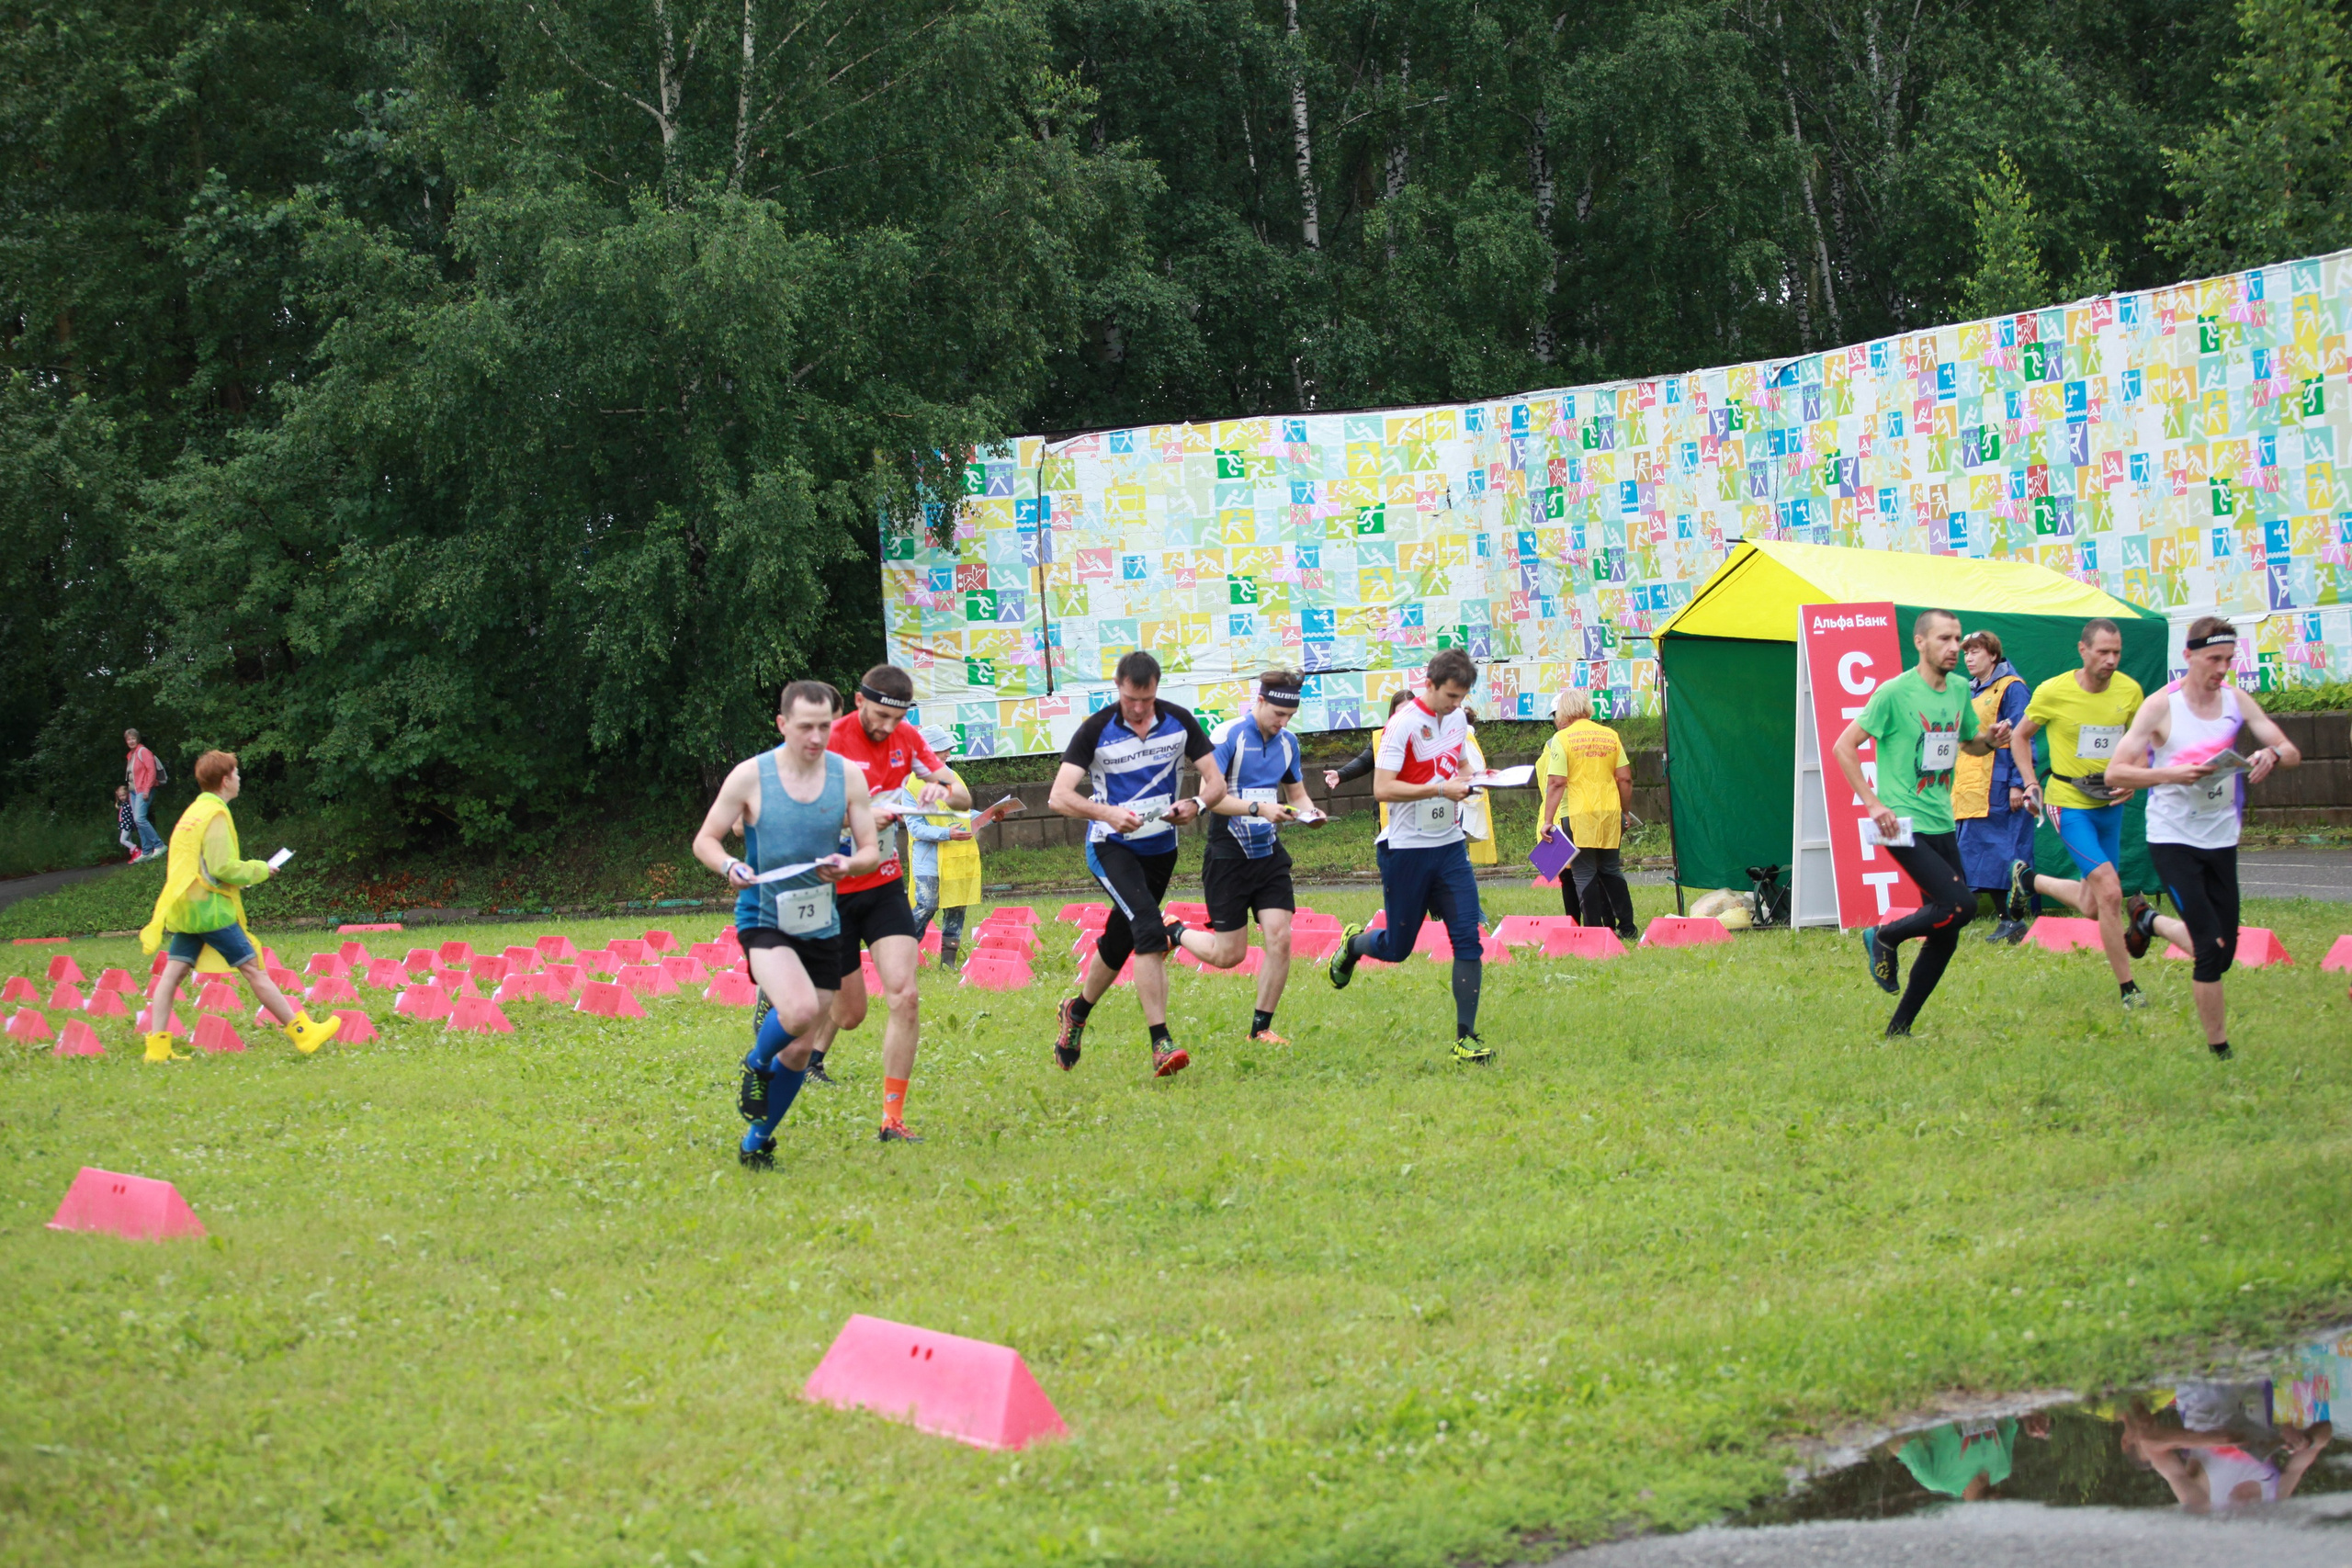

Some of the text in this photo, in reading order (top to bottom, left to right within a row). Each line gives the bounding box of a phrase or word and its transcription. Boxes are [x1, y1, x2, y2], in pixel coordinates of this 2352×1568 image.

[1813, 614, 1888, 634] Альфа Банк
[2094, 738, 2109, 749] 63
[1938, 744, 1950, 756] 66
[2207, 784, 2223, 800] 64
[1431, 807, 1445, 819] 68
[877, 840, 885, 852] 2
[797, 903, 815, 919] 73
